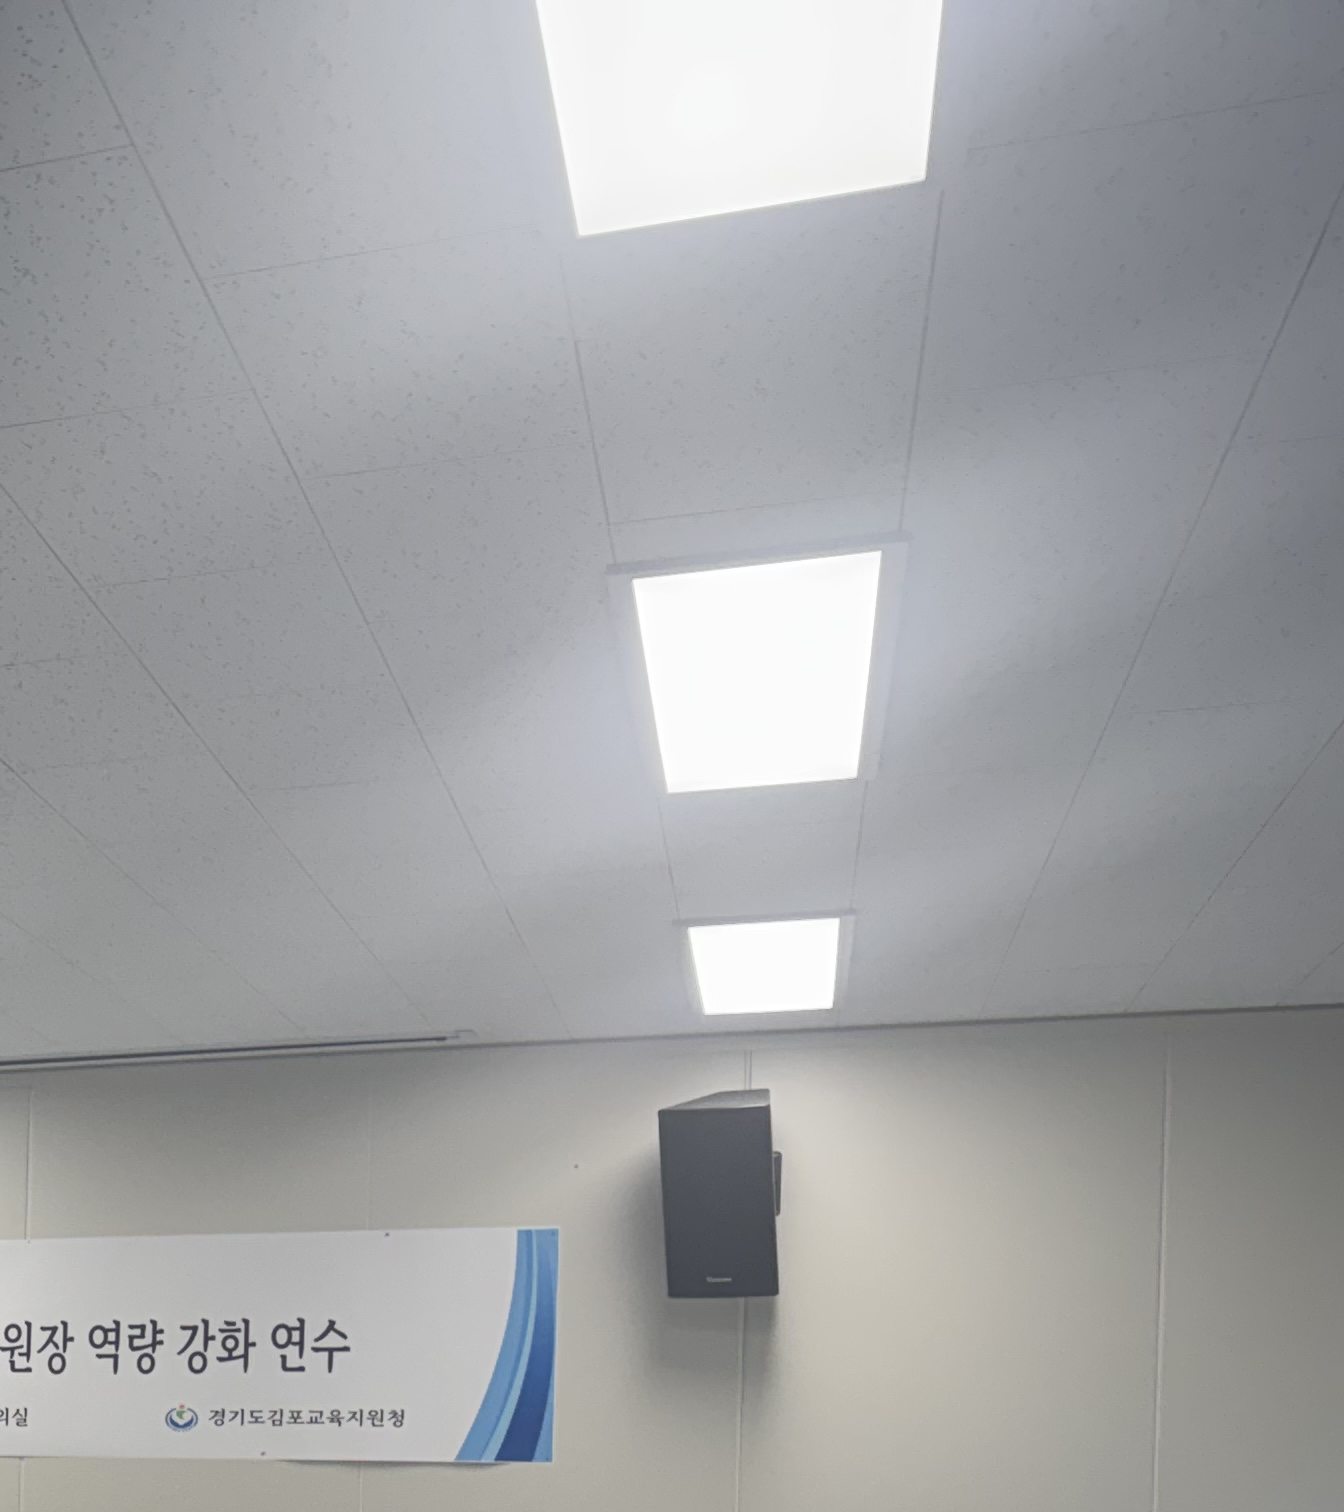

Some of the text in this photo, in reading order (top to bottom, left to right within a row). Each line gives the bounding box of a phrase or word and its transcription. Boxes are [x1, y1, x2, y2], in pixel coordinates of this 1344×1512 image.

[87, 1317, 165, 1376] 역량
[176, 1317, 258, 1375] 강화
[270, 1316, 352, 1375] 연수
[207, 1407, 406, 1429] 경기도김포교육지원청
